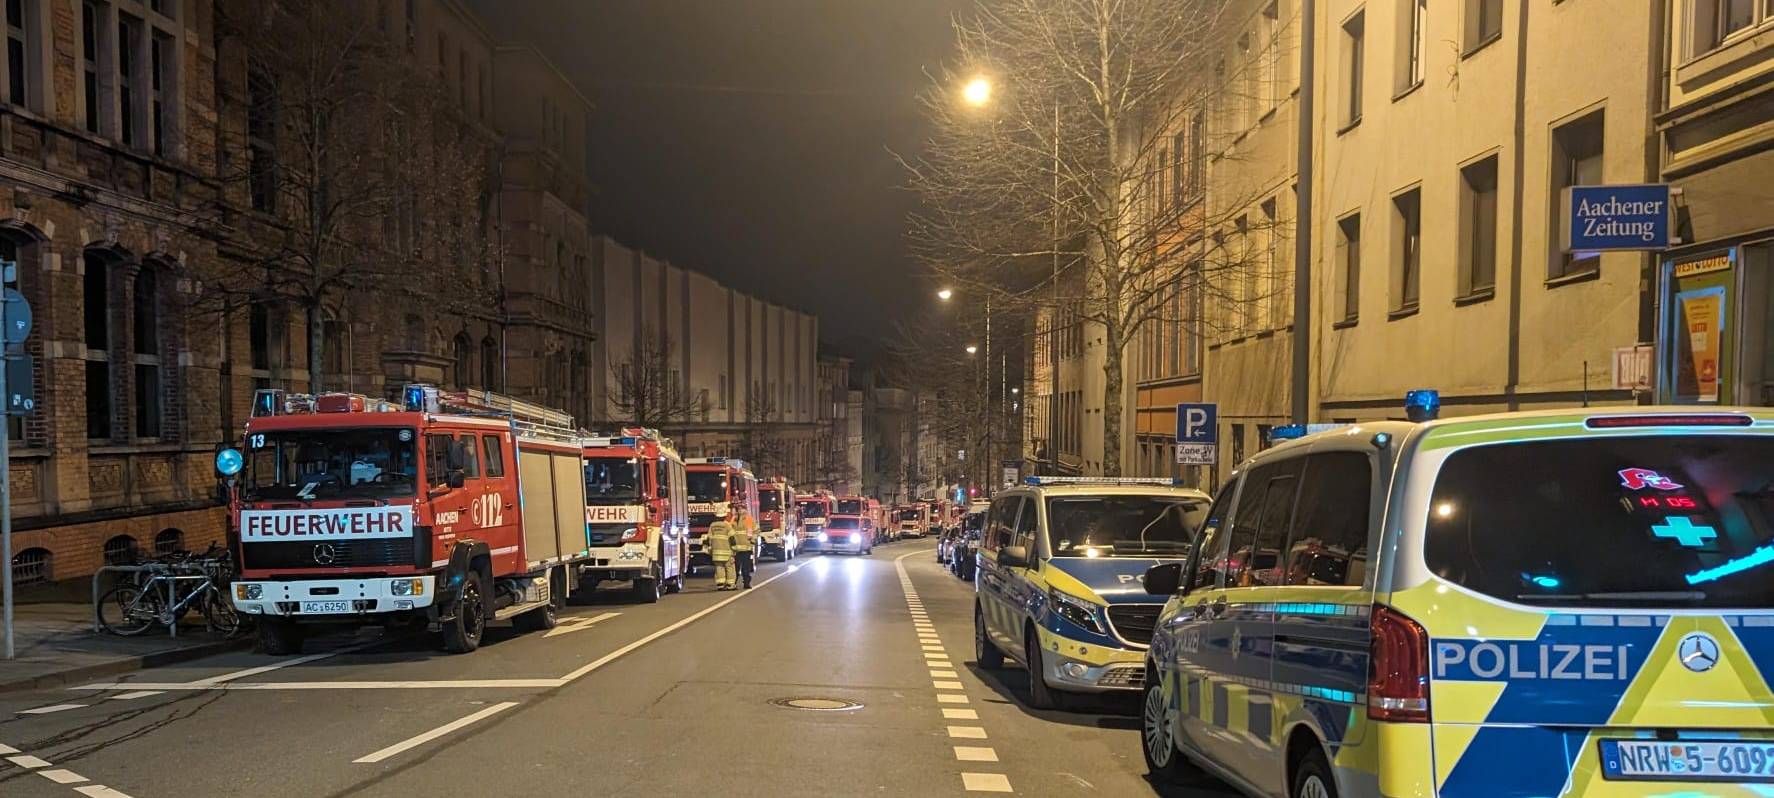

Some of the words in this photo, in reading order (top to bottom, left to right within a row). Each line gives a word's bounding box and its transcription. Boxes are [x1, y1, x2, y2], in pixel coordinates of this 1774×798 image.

[1577, 195, 1663, 218] Aachener
[1583, 217, 1655, 241] Zeitung
[1185, 408, 1207, 438] P
[250, 434, 265, 449] 13
[1179, 446, 1200, 455] Zone
[481, 493, 503, 528] 112
[688, 504, 715, 512] WEHR
[248, 510, 404, 537] FEUERWEHR
[306, 603, 318, 612] AC
[324, 602, 347, 611] 6250
[1436, 643, 1629, 681] POLIZEI
[1609, 760, 1617, 769] D
[1619, 745, 1671, 772] NRW
